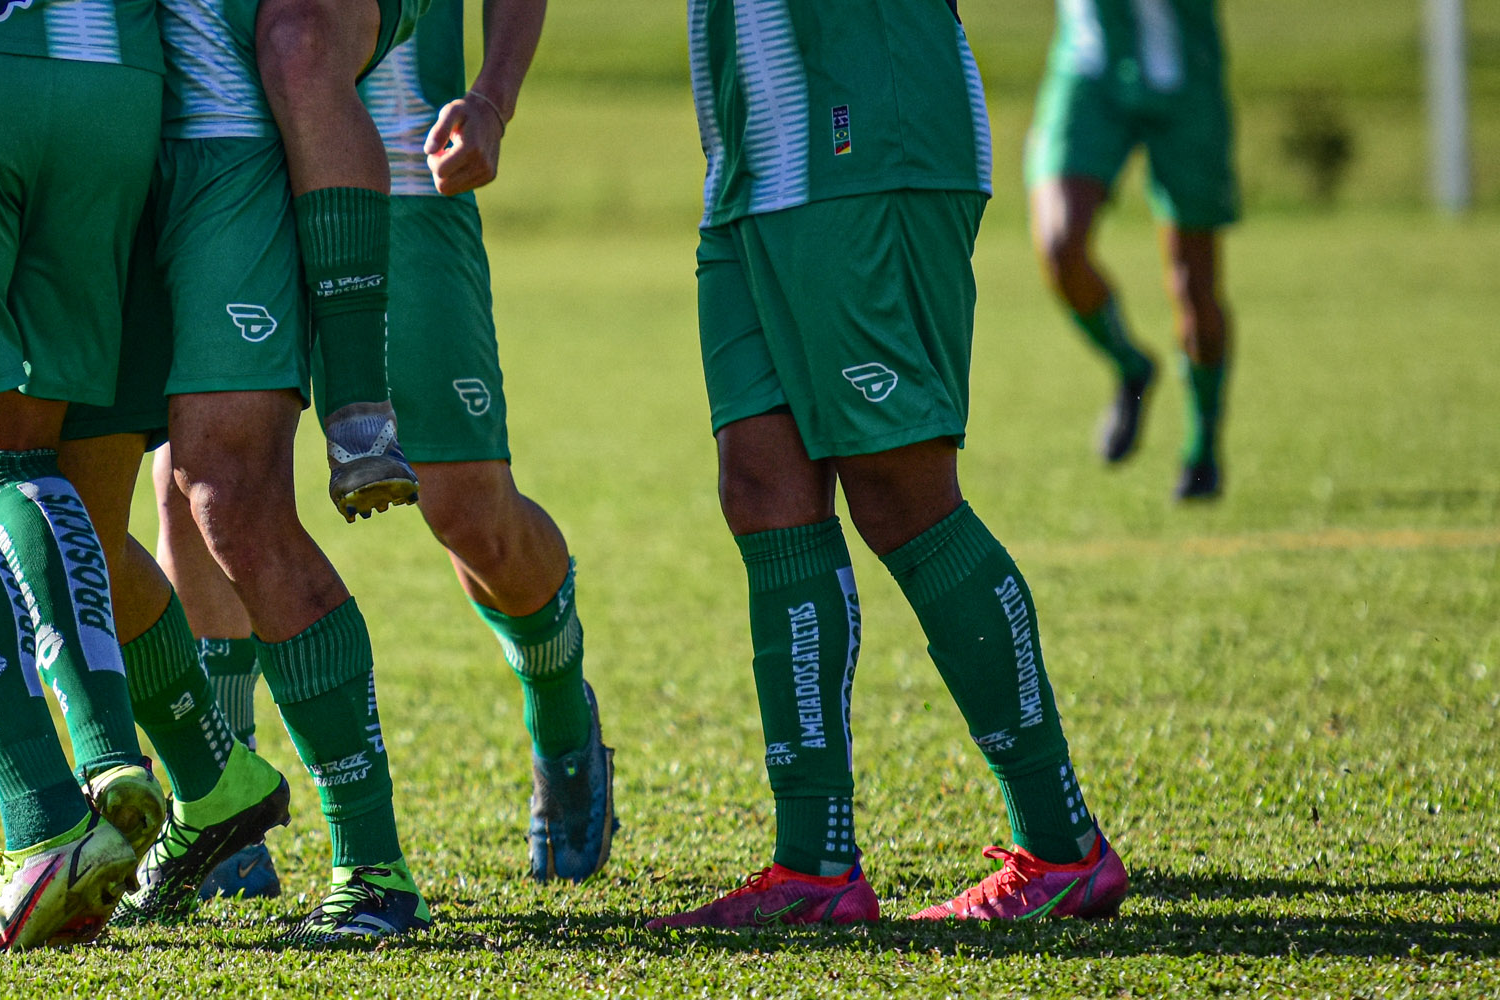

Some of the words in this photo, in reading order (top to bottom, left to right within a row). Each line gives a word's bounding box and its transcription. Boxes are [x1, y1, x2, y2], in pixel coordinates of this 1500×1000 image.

[38, 494, 117, 640] PROSOCKS
[788, 601, 827, 748] AMEIADOSATLETAS
[994, 575, 1044, 728] AMEIADOSATLETAS
